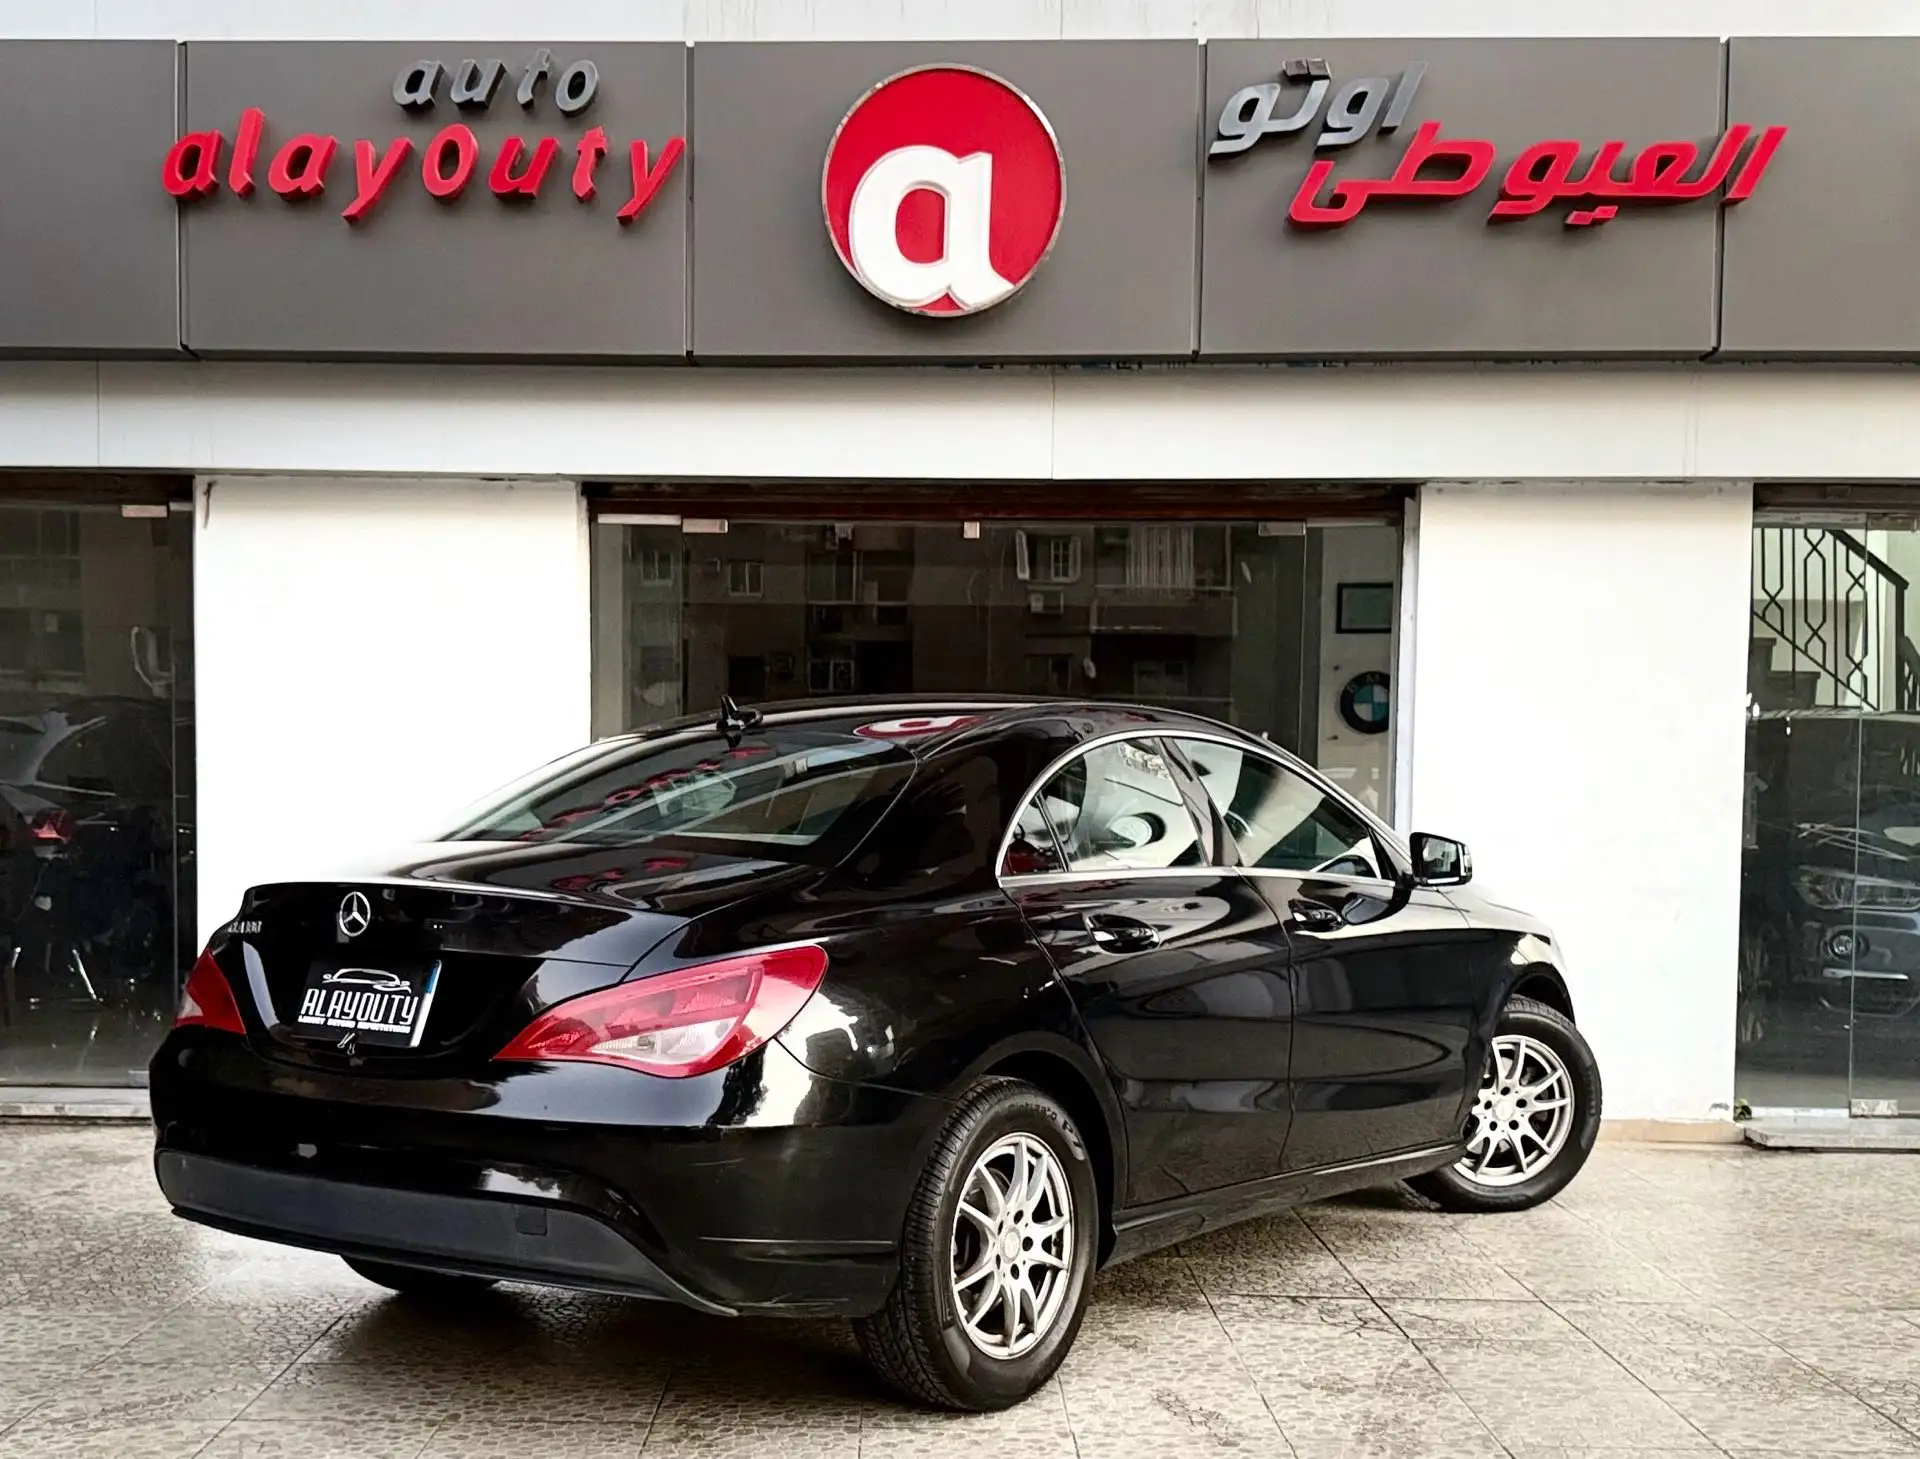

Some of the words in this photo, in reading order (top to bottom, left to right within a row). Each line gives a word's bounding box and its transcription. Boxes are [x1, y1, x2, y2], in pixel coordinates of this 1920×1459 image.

[393, 48, 599, 117] auto
[848, 144, 1015, 310] a
[300, 988, 419, 1026] ALAYOUTY
